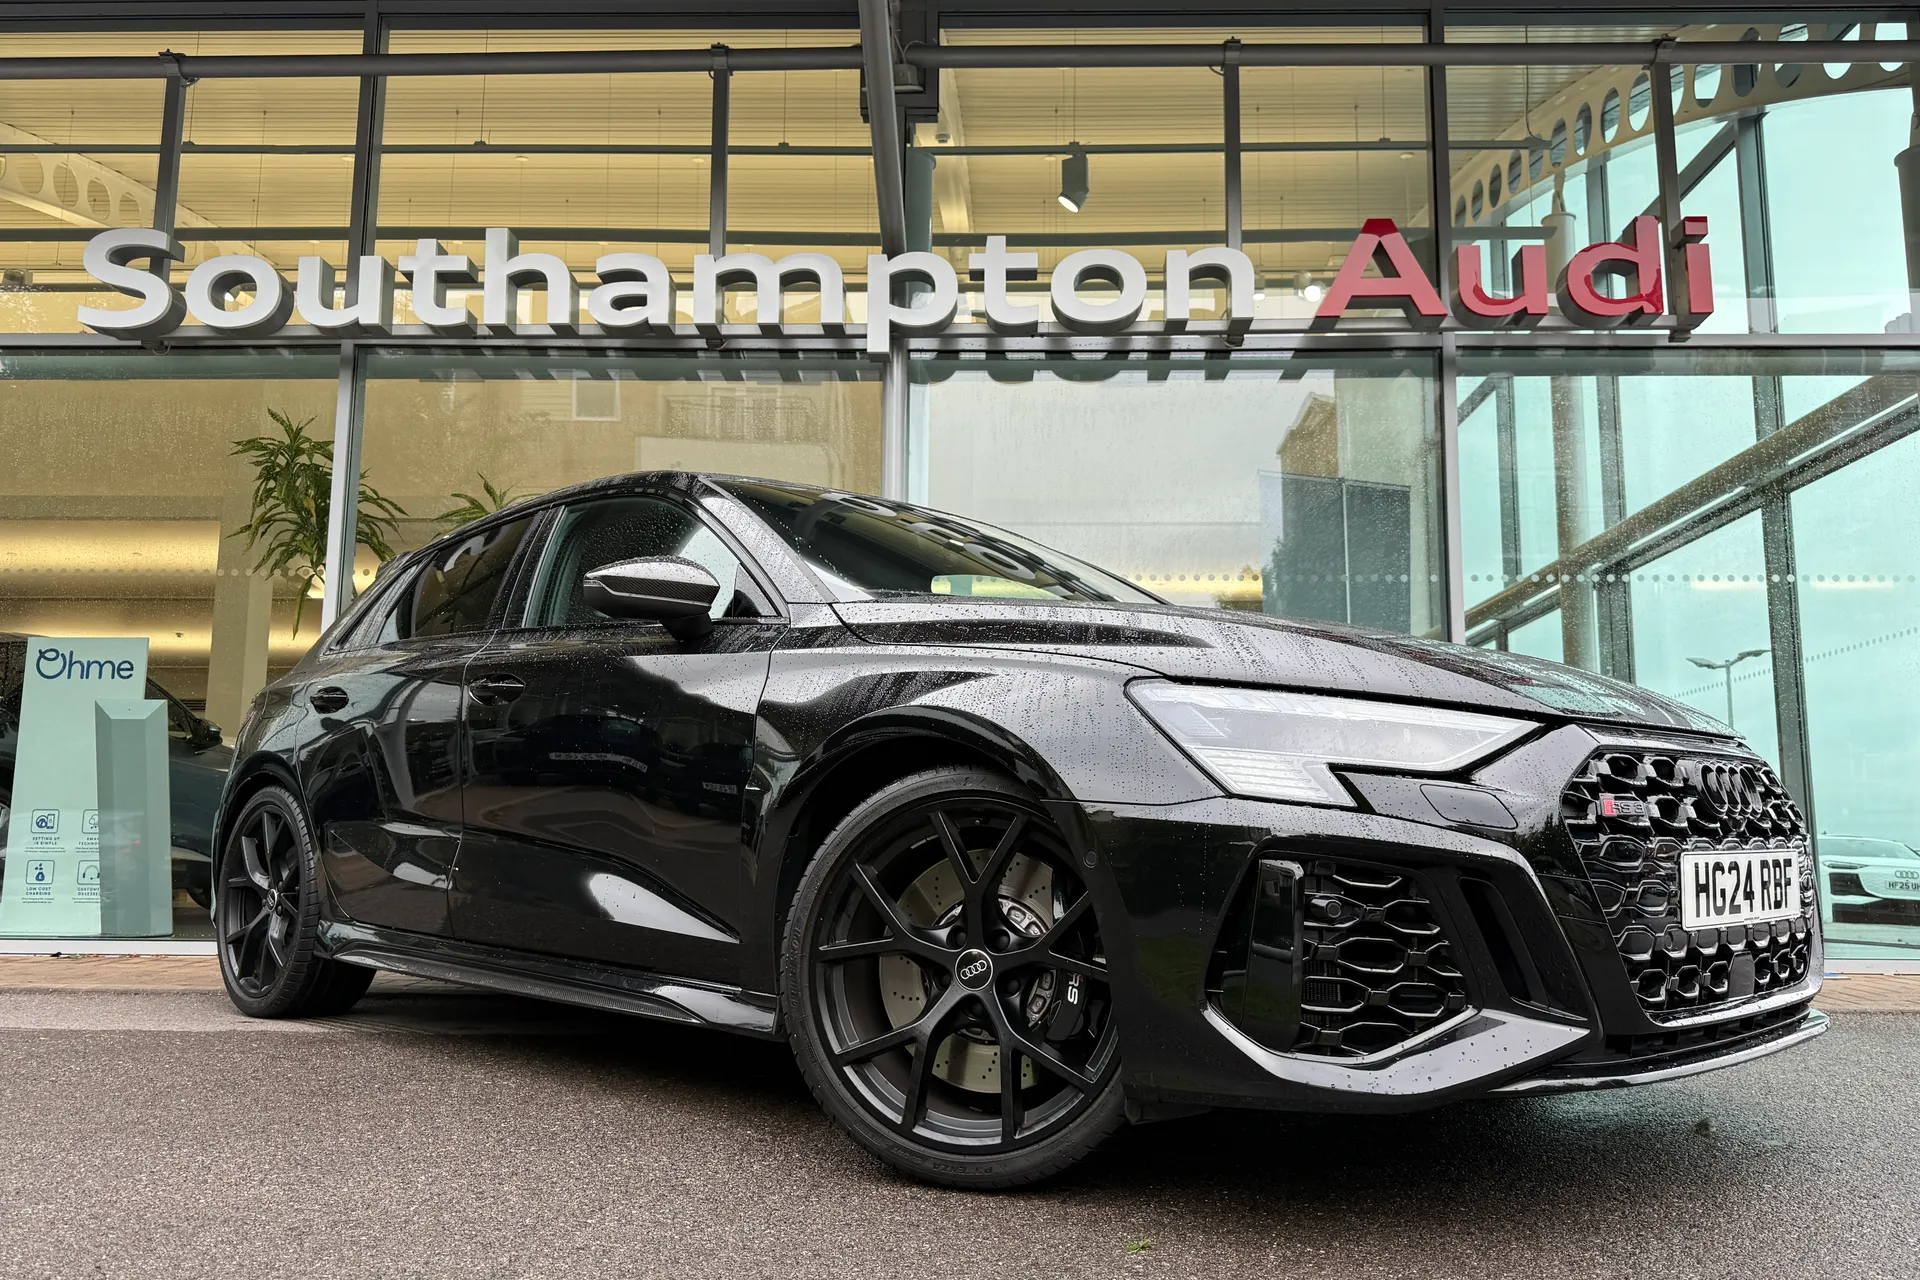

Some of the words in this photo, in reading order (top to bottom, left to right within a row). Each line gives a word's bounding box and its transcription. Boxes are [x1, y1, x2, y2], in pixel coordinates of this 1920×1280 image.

[76, 227, 1256, 358] Southampton
[1311, 215, 1715, 327] Audi
[36, 648, 134, 680] Ohme
[1612, 801, 1631, 814] RS
[1633, 801, 1644, 814] 3
[1694, 859, 1755, 919] HG24
[1760, 858, 1793, 912] RBF
[1888, 881, 1910, 890] HF25
[1067, 973, 1080, 1005] RS
[932, 1162, 993, 1176] POTENZA
